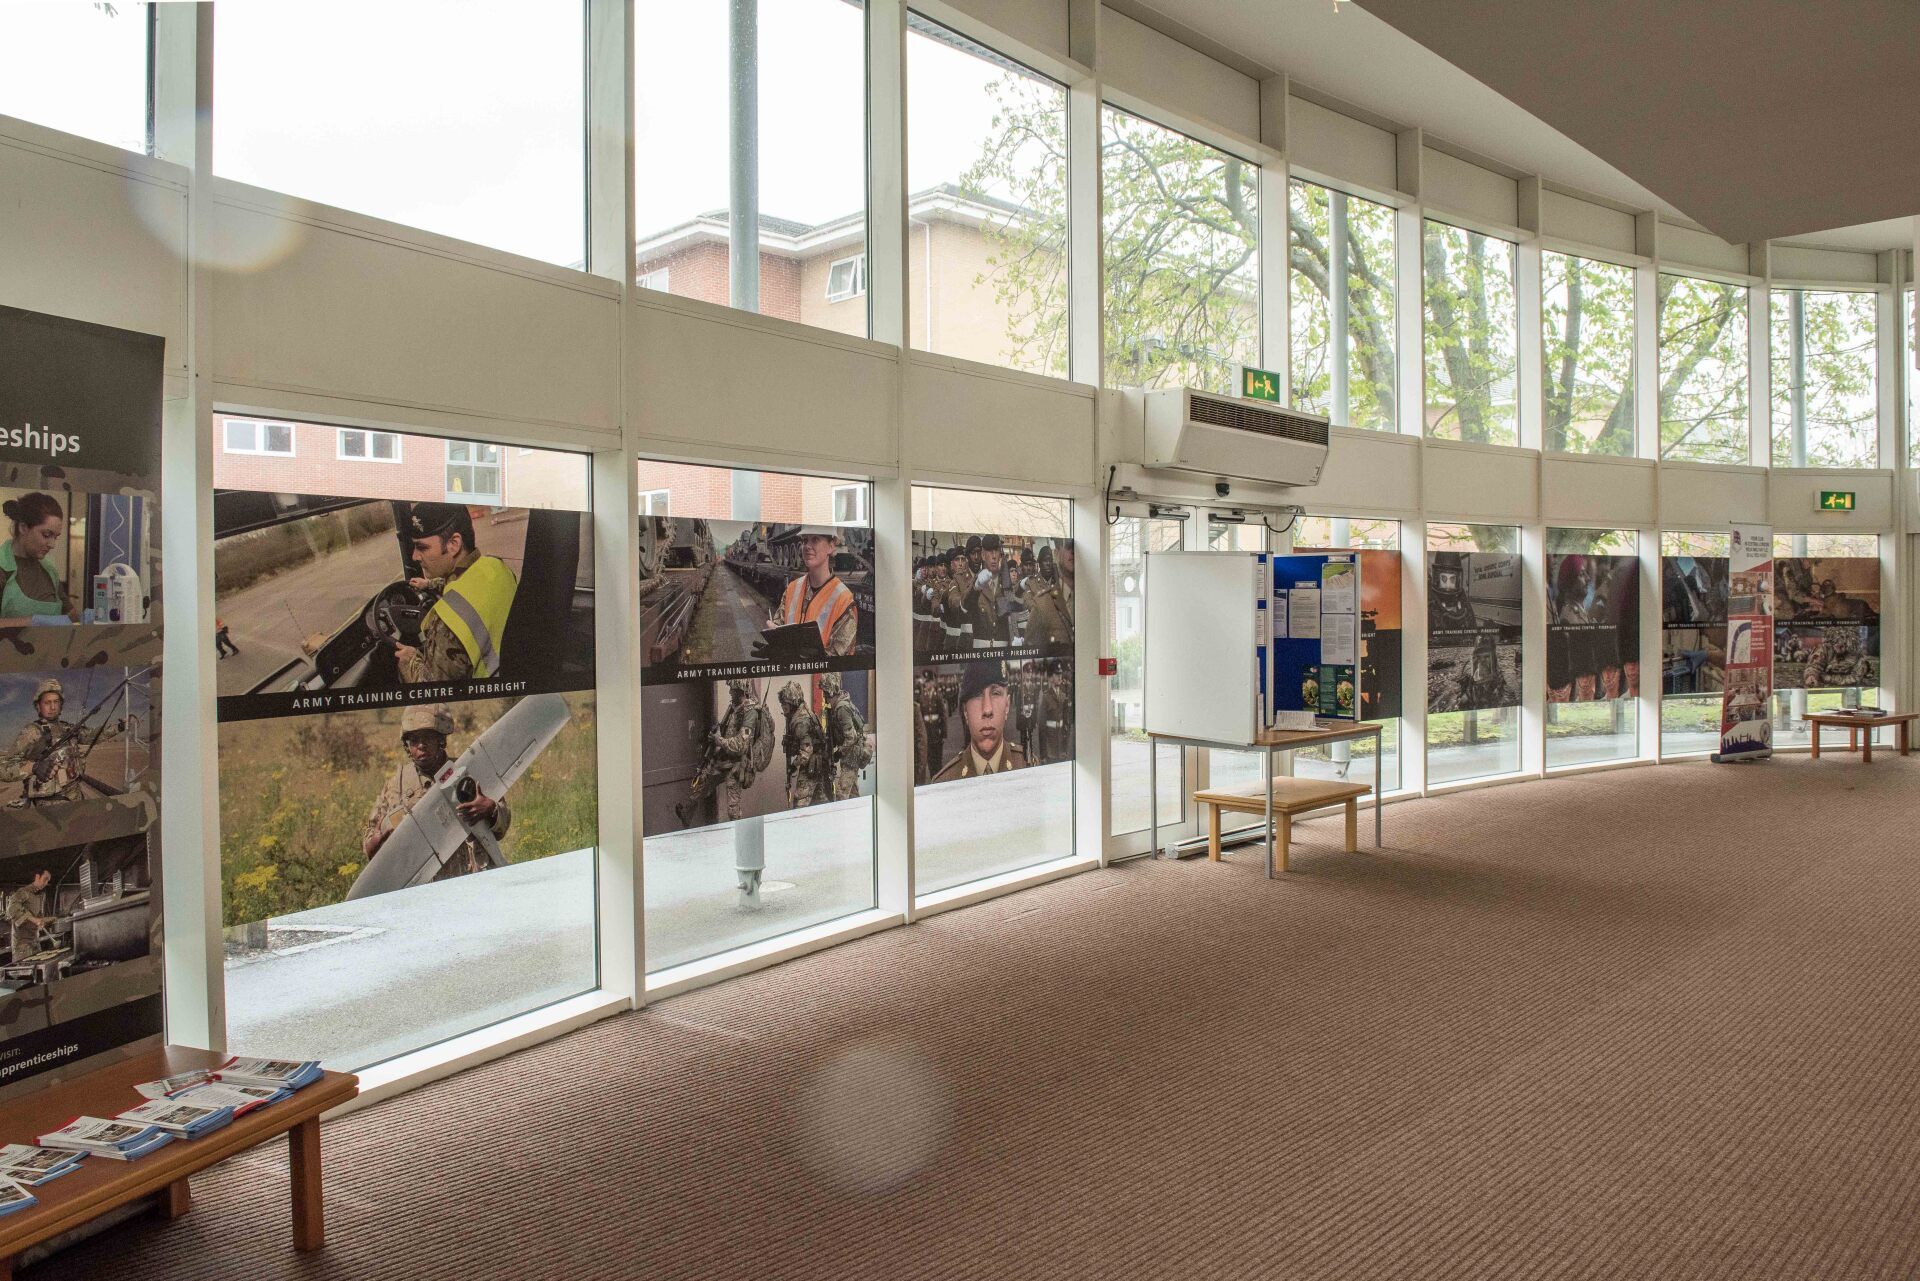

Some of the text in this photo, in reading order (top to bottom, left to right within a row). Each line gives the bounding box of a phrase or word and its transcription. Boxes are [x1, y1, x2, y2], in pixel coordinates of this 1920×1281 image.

[930, 648, 1040, 662] ARMY TRAINING CENTRE PIRBRIGHT
[677, 661, 830, 679] ARMY TRAINING CENTRE PIRBRIGHT
[292, 681, 528, 709] ARMY TRAINING CENTRE PIRBRIGHT
